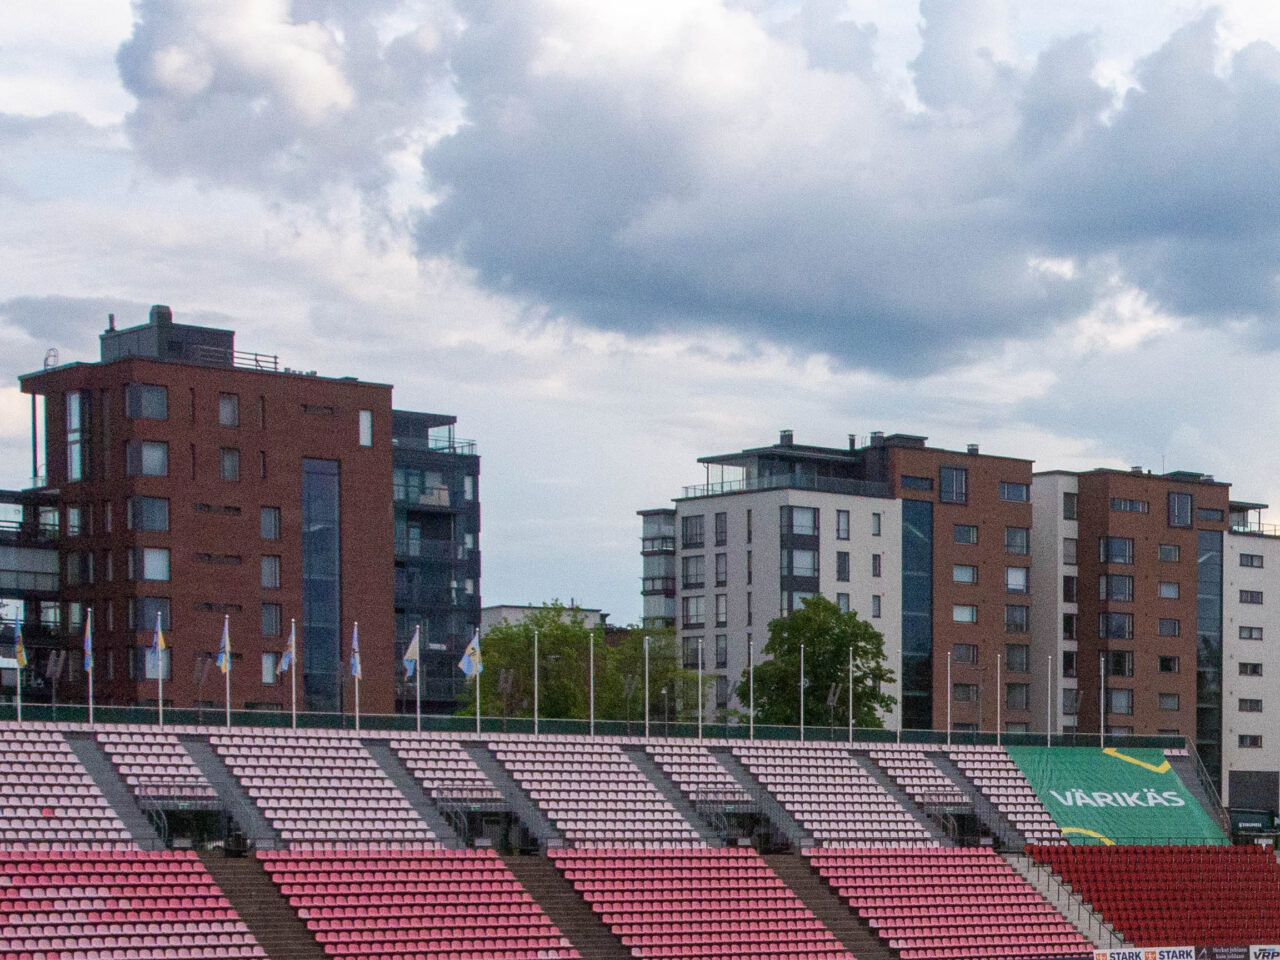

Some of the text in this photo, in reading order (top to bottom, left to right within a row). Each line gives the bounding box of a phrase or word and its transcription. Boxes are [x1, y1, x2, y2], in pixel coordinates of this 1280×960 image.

[1049, 788, 1186, 808] VÄRIKÄS
[1158, 949, 1193, 960] STARK
[1253, 952, 1280, 960] VRP
